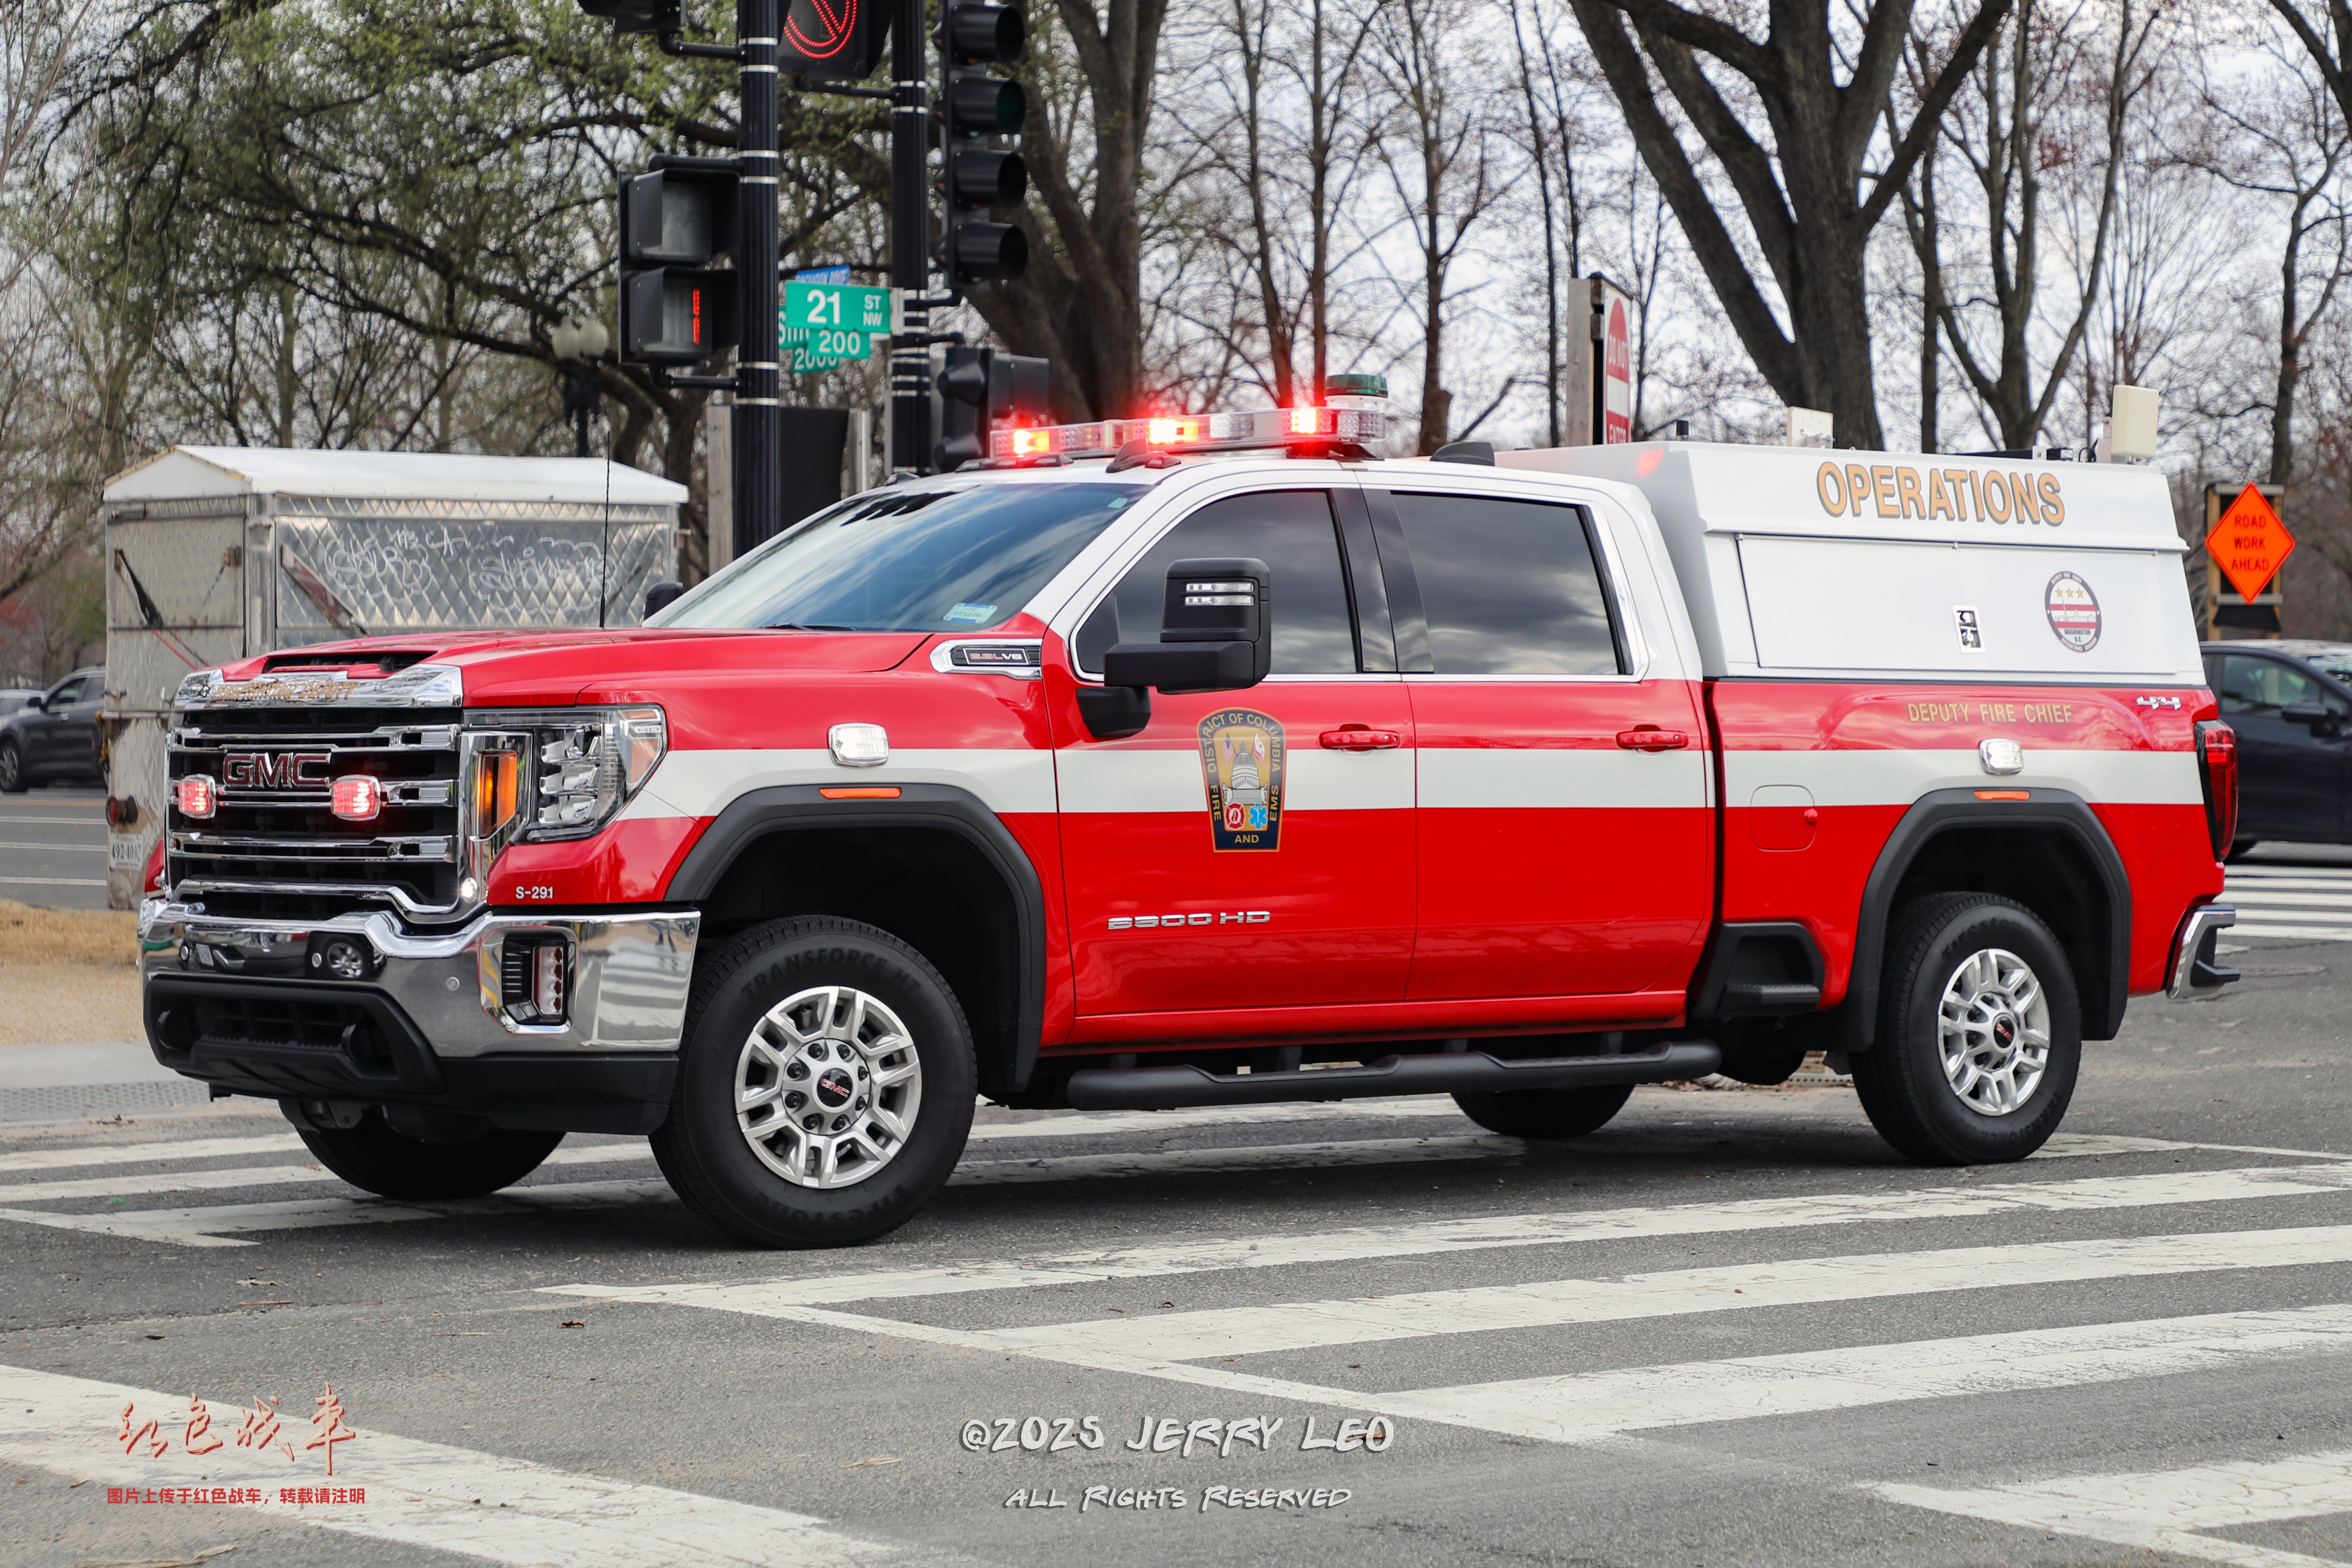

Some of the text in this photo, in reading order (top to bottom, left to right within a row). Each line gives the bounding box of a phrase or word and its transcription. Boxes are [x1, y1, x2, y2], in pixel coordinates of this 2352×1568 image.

[807, 289, 882, 324] 21 ST
[863, 311, 882, 326] NW
[819, 329, 861, 355] 200
[1816, 461, 2065, 527] OPERATIONS
[2235, 515, 2266, 528] ROAD
[2234, 537, 2265, 549] WORK
[2231, 558, 2269, 572] AHEAD
[299, 682, 360, 699] DEPUTY
[1908, 703, 2072, 723] DEPUTY FIRE CHIEF
[1203, 713, 1280, 773] DISTRICT OF COLUMBIA
[223, 752, 331, 788] GMC
[1211, 785, 1222, 821] FIRE
[1270, 785, 1279, 821] EMS
[1235, 835, 1259, 843] AND
[515, 886, 553, 899] S-291
[1219, 911, 1270, 924] HD
[741, 948, 922, 1000] TRANSFORCE HT
[1996, 1023, 2013, 1042] GMC
[821, 1079, 850, 1098] GMC
